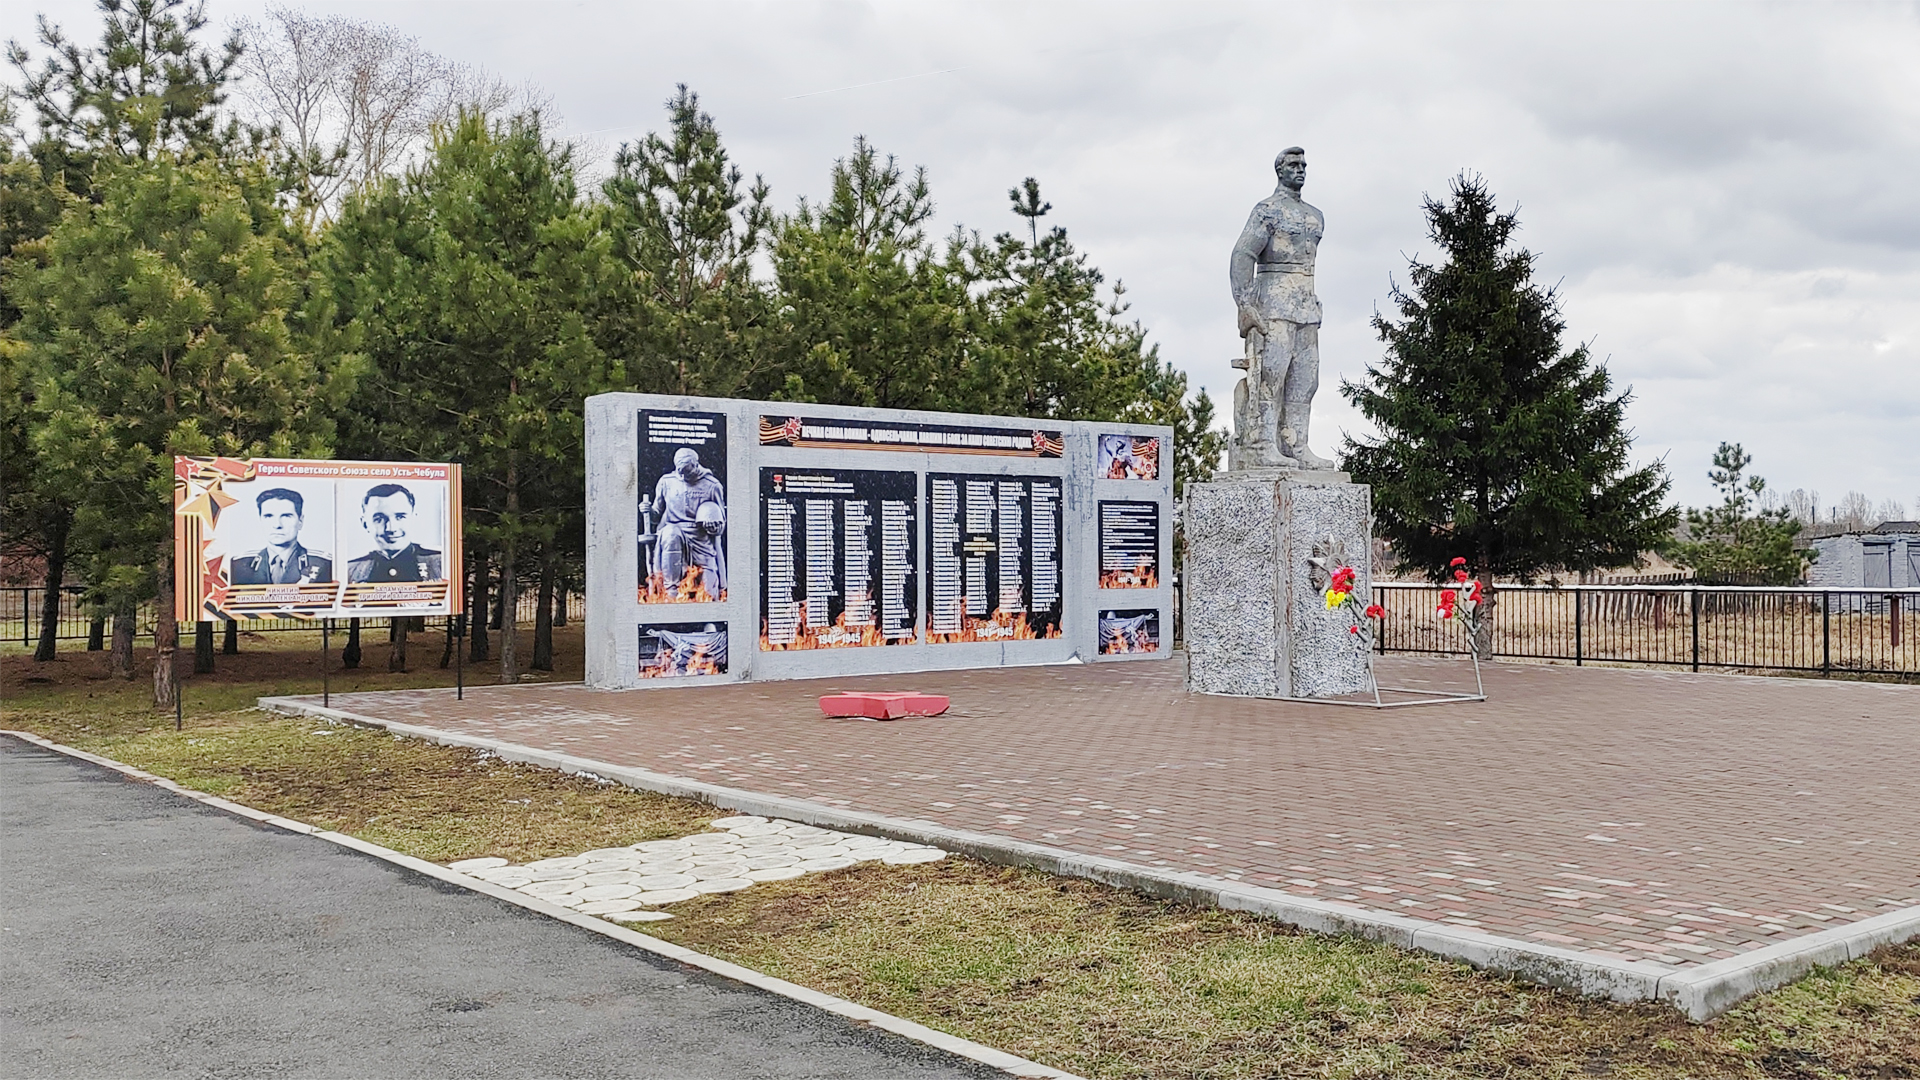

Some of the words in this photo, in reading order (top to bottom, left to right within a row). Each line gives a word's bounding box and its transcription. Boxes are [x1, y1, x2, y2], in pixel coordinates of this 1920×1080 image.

[258, 464, 286, 474] Герои
[287, 465, 339, 475] Советского
[340, 466, 369, 476] Союза
[370, 468, 391, 476] село
[392, 467, 445, 479] Усть-Чебула
